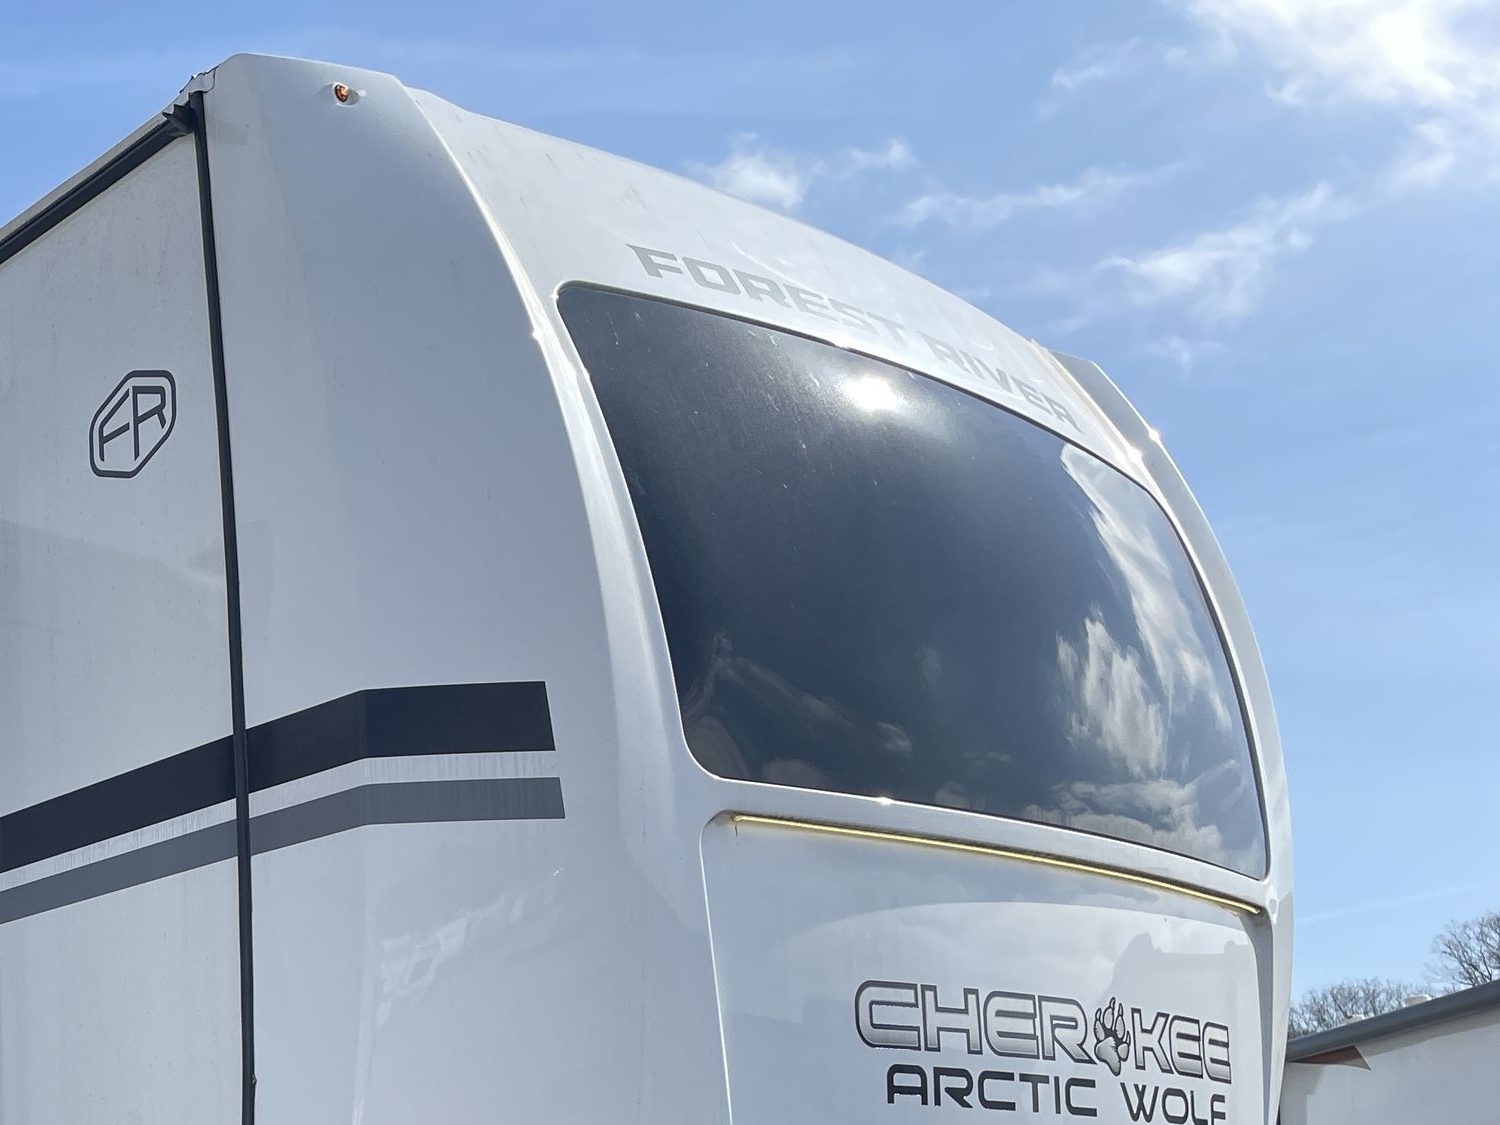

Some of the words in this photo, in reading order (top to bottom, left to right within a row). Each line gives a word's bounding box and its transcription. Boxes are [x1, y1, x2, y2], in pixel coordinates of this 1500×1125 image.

[625, 243, 909, 345] FOREST
[917, 330, 1084, 434] RIVER
[886, 1063, 1098, 1118] ARCTIC
